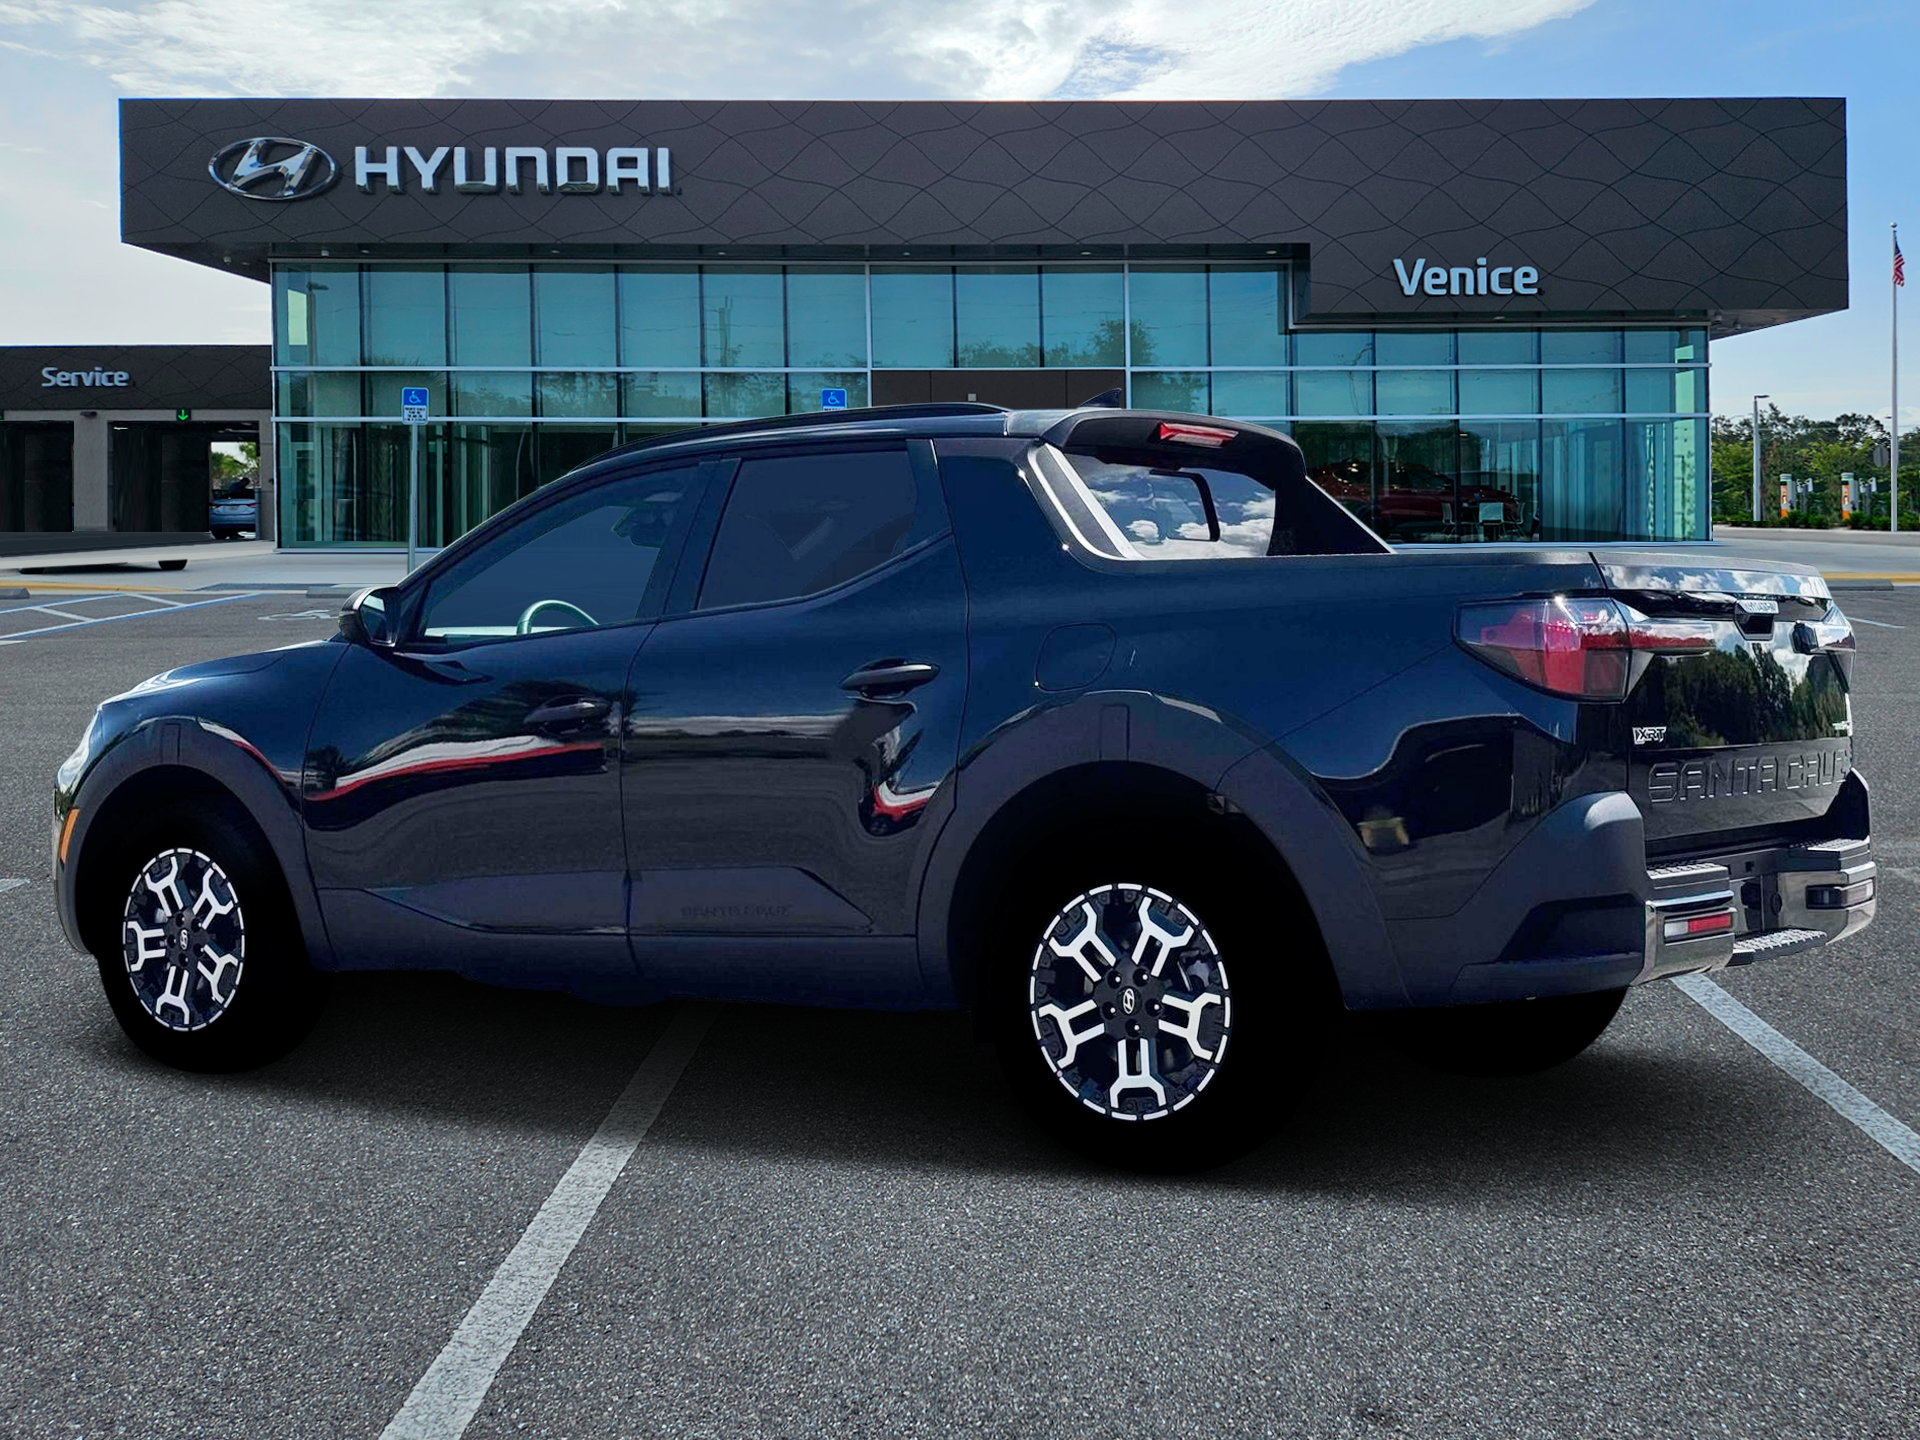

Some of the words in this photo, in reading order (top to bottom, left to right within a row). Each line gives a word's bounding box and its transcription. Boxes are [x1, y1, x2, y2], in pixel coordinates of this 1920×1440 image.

[355, 146, 671, 194] HYUNDAI
[1393, 257, 1538, 295] Venice
[41, 366, 130, 387] Service
[1633, 726, 1667, 744] XRT
[1649, 757, 1778, 802] SANTA
